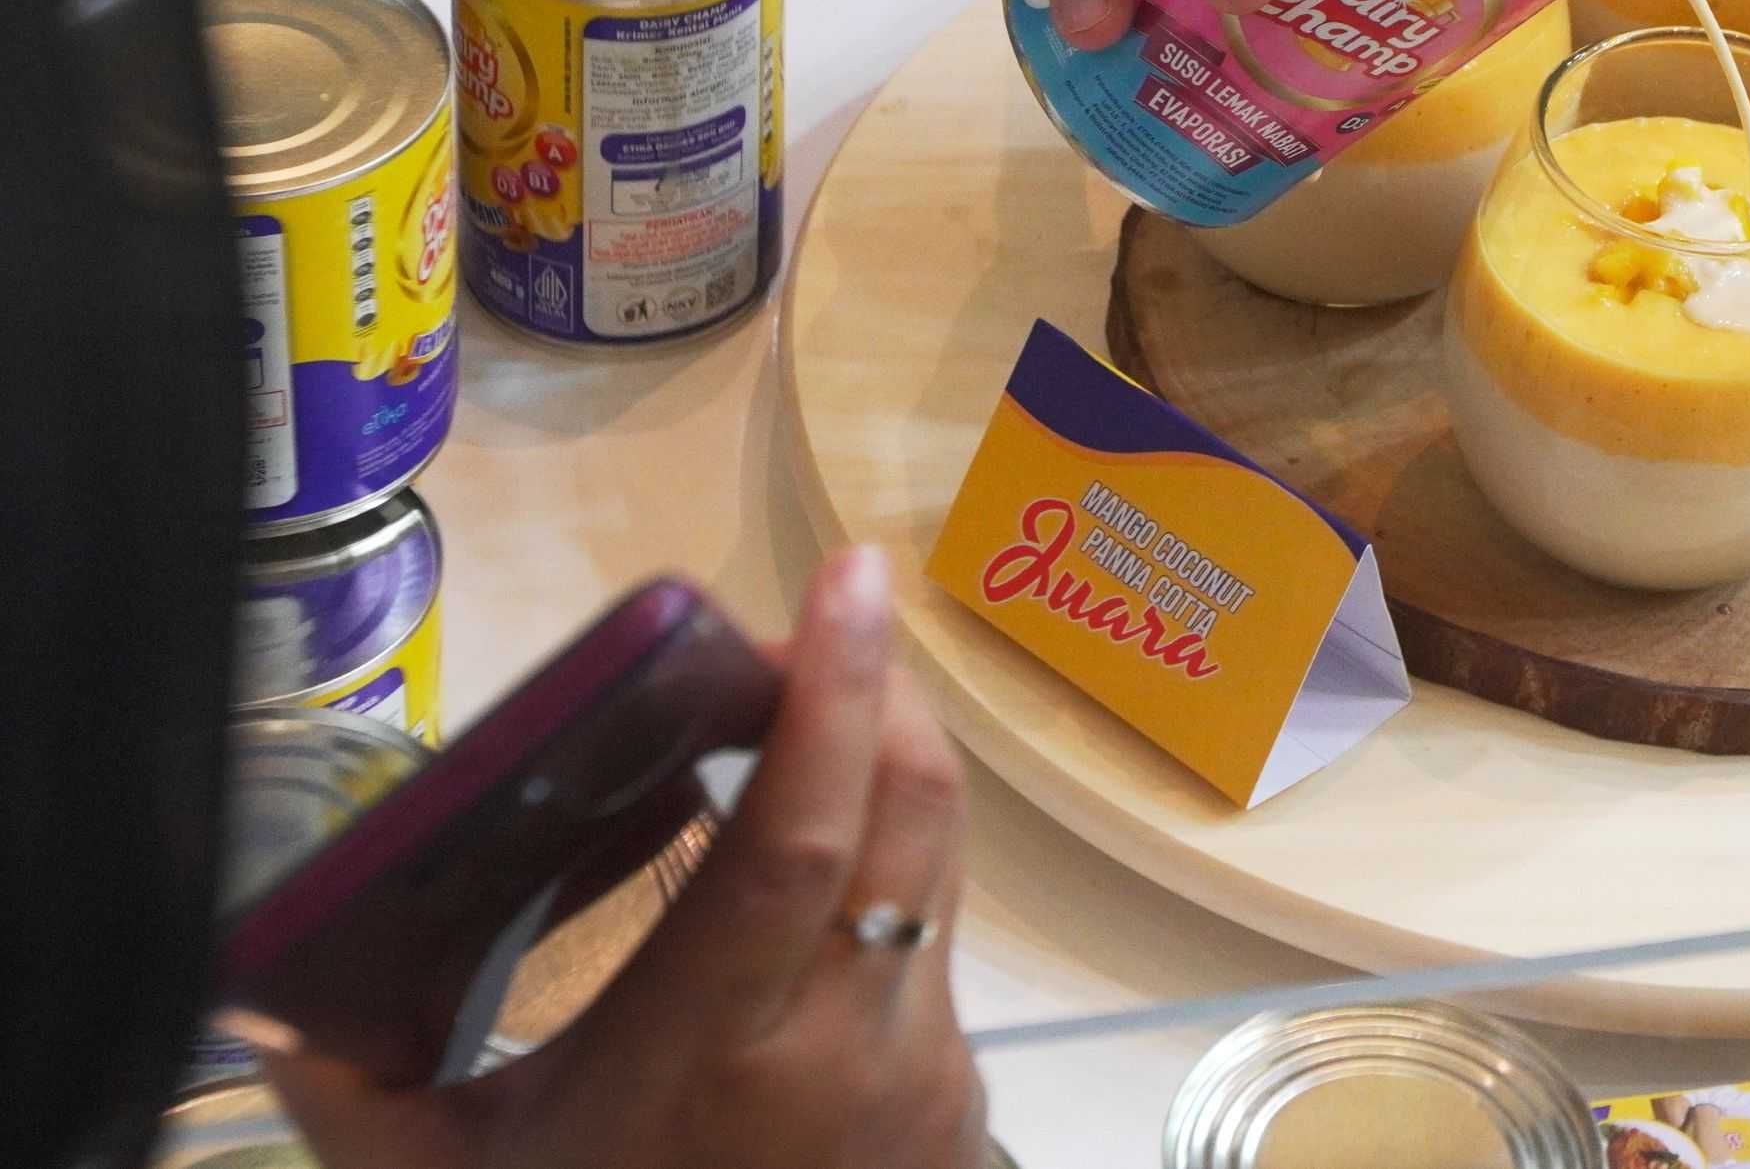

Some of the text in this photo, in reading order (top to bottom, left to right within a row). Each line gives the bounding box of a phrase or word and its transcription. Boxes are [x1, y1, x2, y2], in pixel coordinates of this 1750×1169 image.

[639, 2, 728, 31] DAIRY CHAMP
[1148, 88, 1252, 168] EVAPORASI
[1159, 43, 1308, 159] SUSU LEMAK NABATI
[1340, 116, 1369, 131] D3
[548, 144, 563, 162] A
[982, 498, 1221, 679] Juara
[1080, 481, 1254, 614] MANGO COCONUT
[1080, 527, 1218, 640] PANNA COTTA
